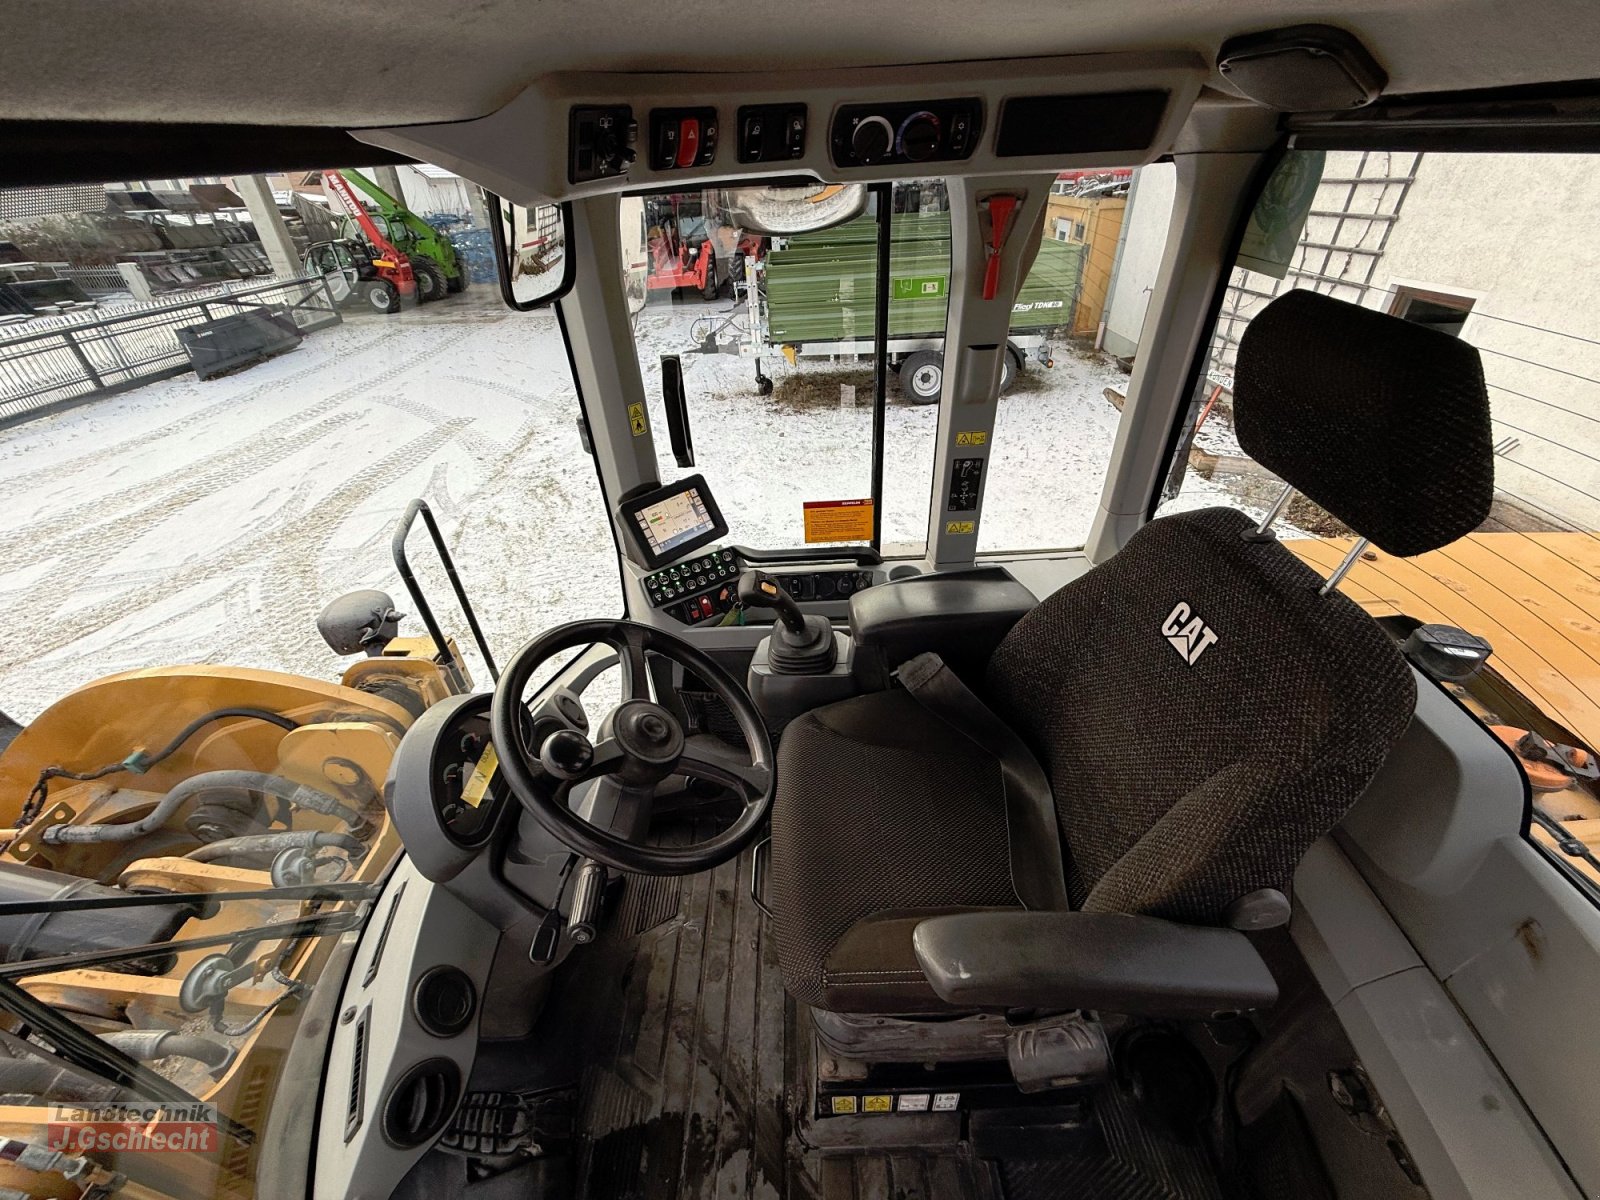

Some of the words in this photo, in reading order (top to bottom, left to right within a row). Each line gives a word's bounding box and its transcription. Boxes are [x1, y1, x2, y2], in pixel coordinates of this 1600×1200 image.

[328, 174, 363, 217] MANITOU
[1012, 303, 1034, 312] Fliegl
[1161, 601, 1219, 667] CAT
